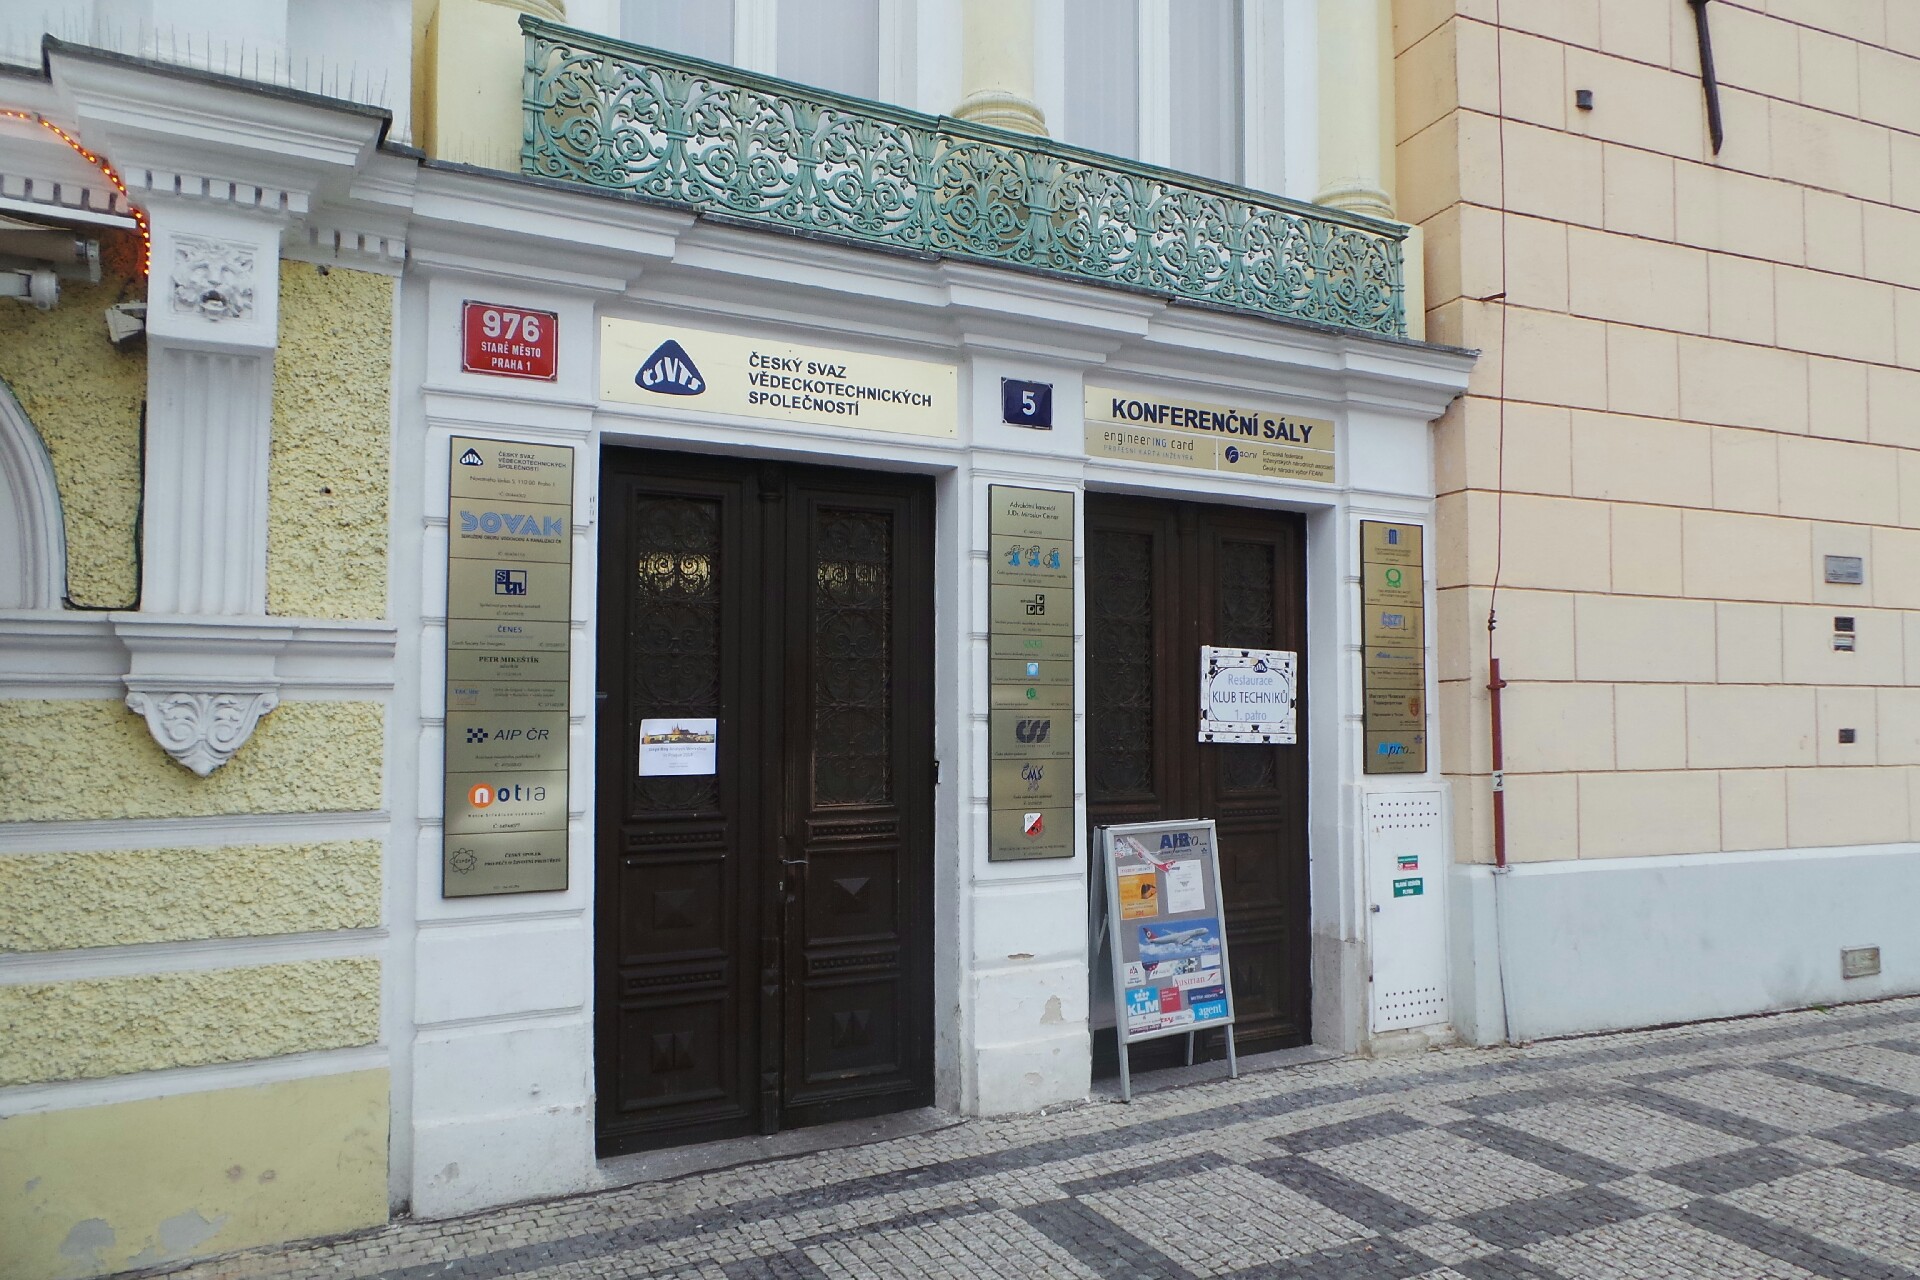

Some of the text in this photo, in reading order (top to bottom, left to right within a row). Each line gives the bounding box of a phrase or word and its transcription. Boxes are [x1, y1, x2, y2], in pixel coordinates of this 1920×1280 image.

[482, 309, 540, 343] 976
[481, 340, 541, 358] STARÉ MĚSTO
[491, 357, 531, 371] PRAHA 1
[641, 355, 702, 392] ČSVTS
[749, 351, 847, 379] ČESKÝ SVAZ
[748, 371, 932, 408] VĚDECKOTECHNICKÝCH
[749, 391, 859, 416] SPOLEČNOSTÍ
[1021, 390, 1037, 417] 5
[1111, 397, 1314, 444] KONFERENČNÍ SÁLY
[1103, 430, 1194, 451] engineerING card
[460, 510, 563, 538] SOVAK
[497, 624, 523, 634] ČENES
[1227, 673, 1273, 686] Restaurace
[1212, 690, 1288, 704] KLUB TECHNIKŮ
[1245, 710, 1267, 721] patro
[493, 727, 549, 741] AIP ČR
[467, 783, 546, 809] notia
[1173, 975, 1205, 989] Austrian
[1127, 1000, 1159, 1017] KLM
[1198, 1003, 1222, 1019] agent
